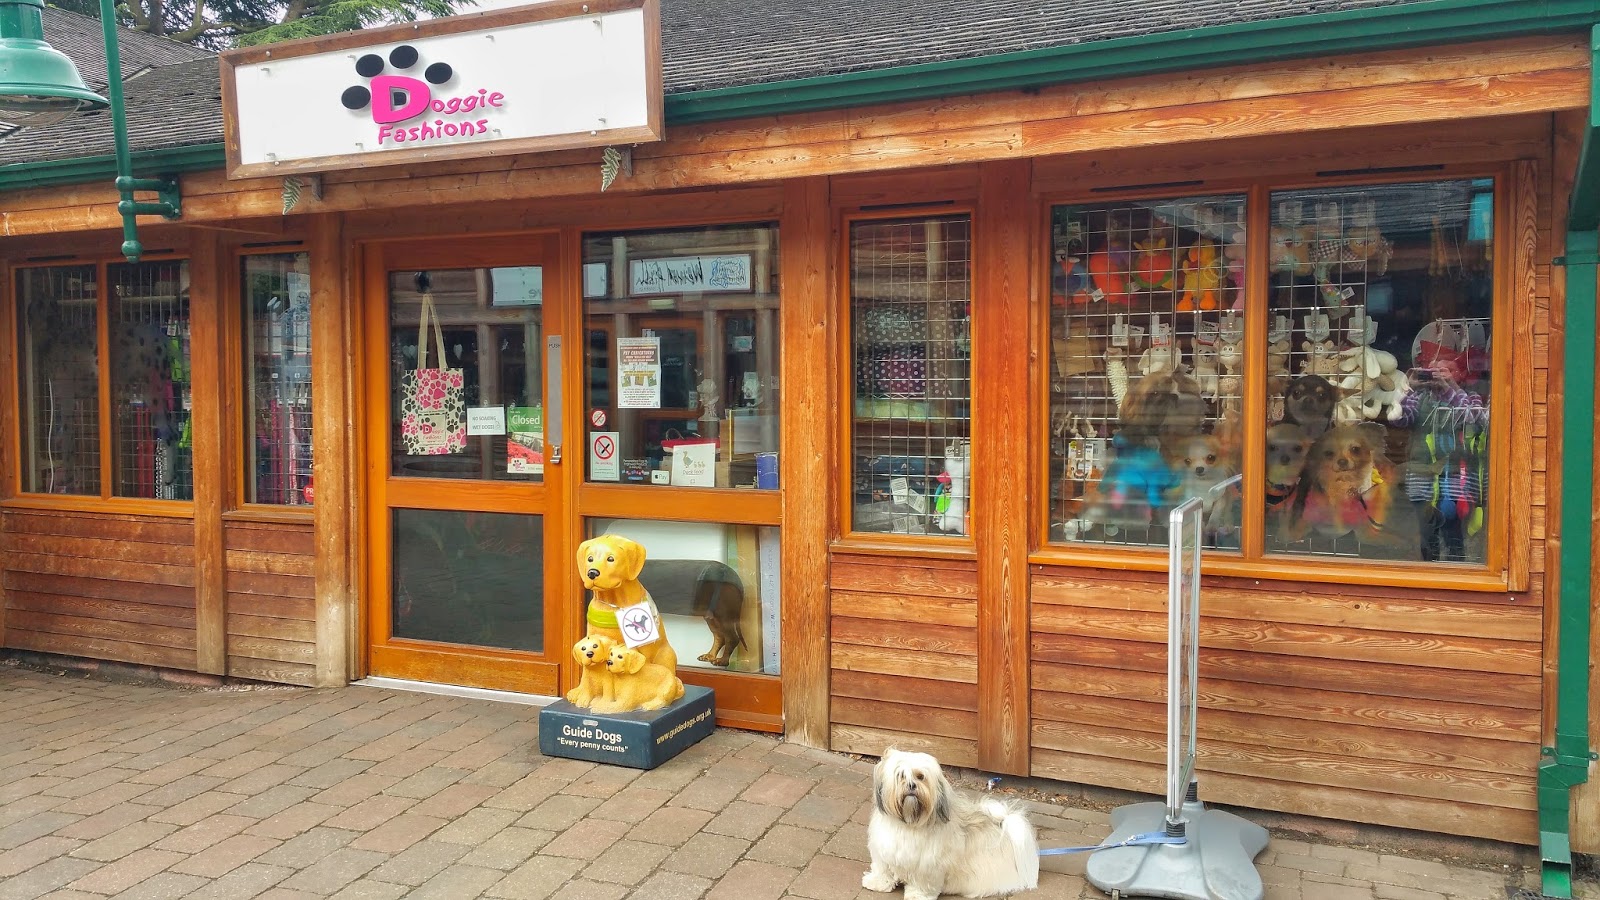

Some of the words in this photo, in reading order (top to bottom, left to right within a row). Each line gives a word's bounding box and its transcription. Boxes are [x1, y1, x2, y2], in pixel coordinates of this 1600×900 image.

[370, 75, 504, 125] Doggie
[378, 120, 488, 145] Fashions
[512, 415, 540, 425] Closed
[562, 725, 593, 739] Guide
[595, 729, 622, 743] Dogs
[656, 708, 712, 745] www.guidedogs.org.uk
[580, 741, 601, 751] penny
